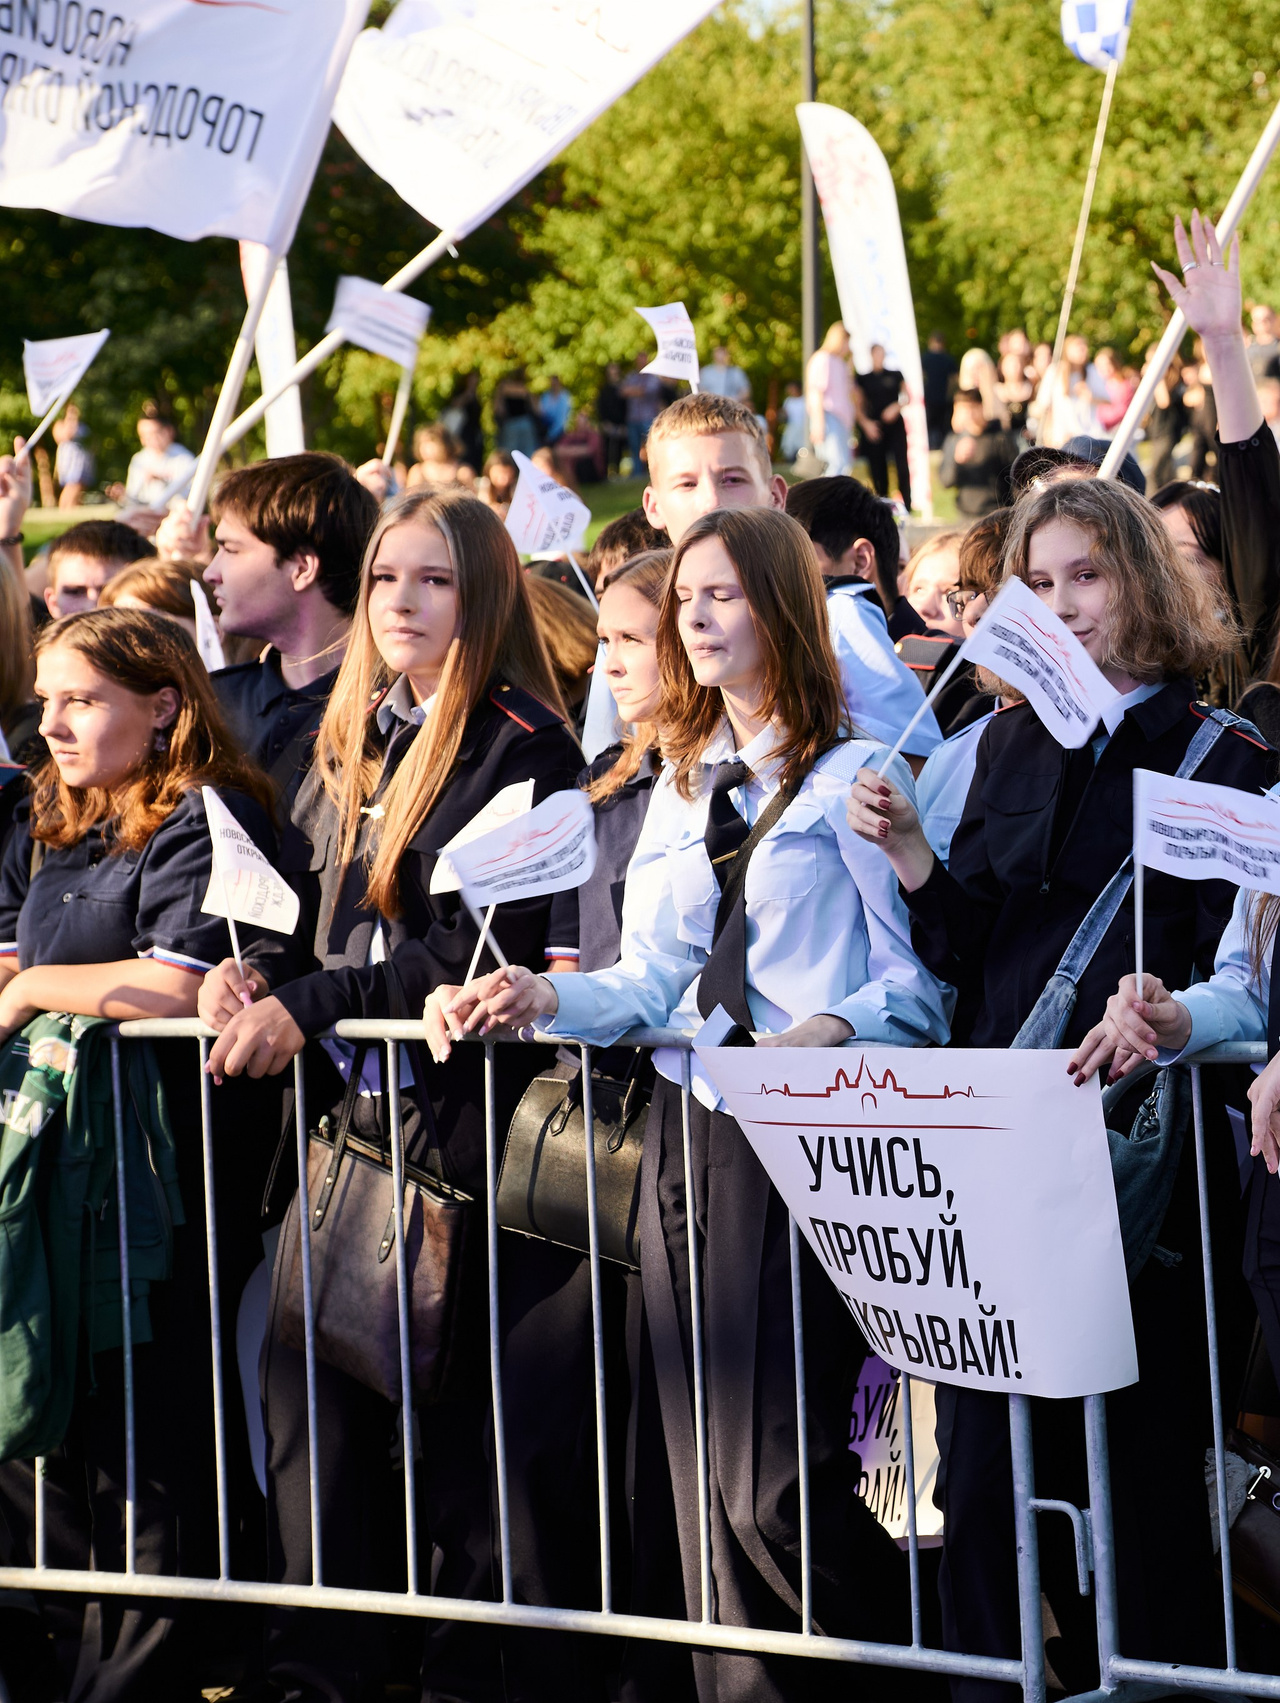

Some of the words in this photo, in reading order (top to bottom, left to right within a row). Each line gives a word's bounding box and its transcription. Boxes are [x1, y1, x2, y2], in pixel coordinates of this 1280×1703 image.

[798, 1135, 954, 1209] УЧИСЬ,
[808, 1213, 981, 1300] ПРОБУЙ,
[840, 1289, 1022, 1380] ТКРЫВАЙ!
